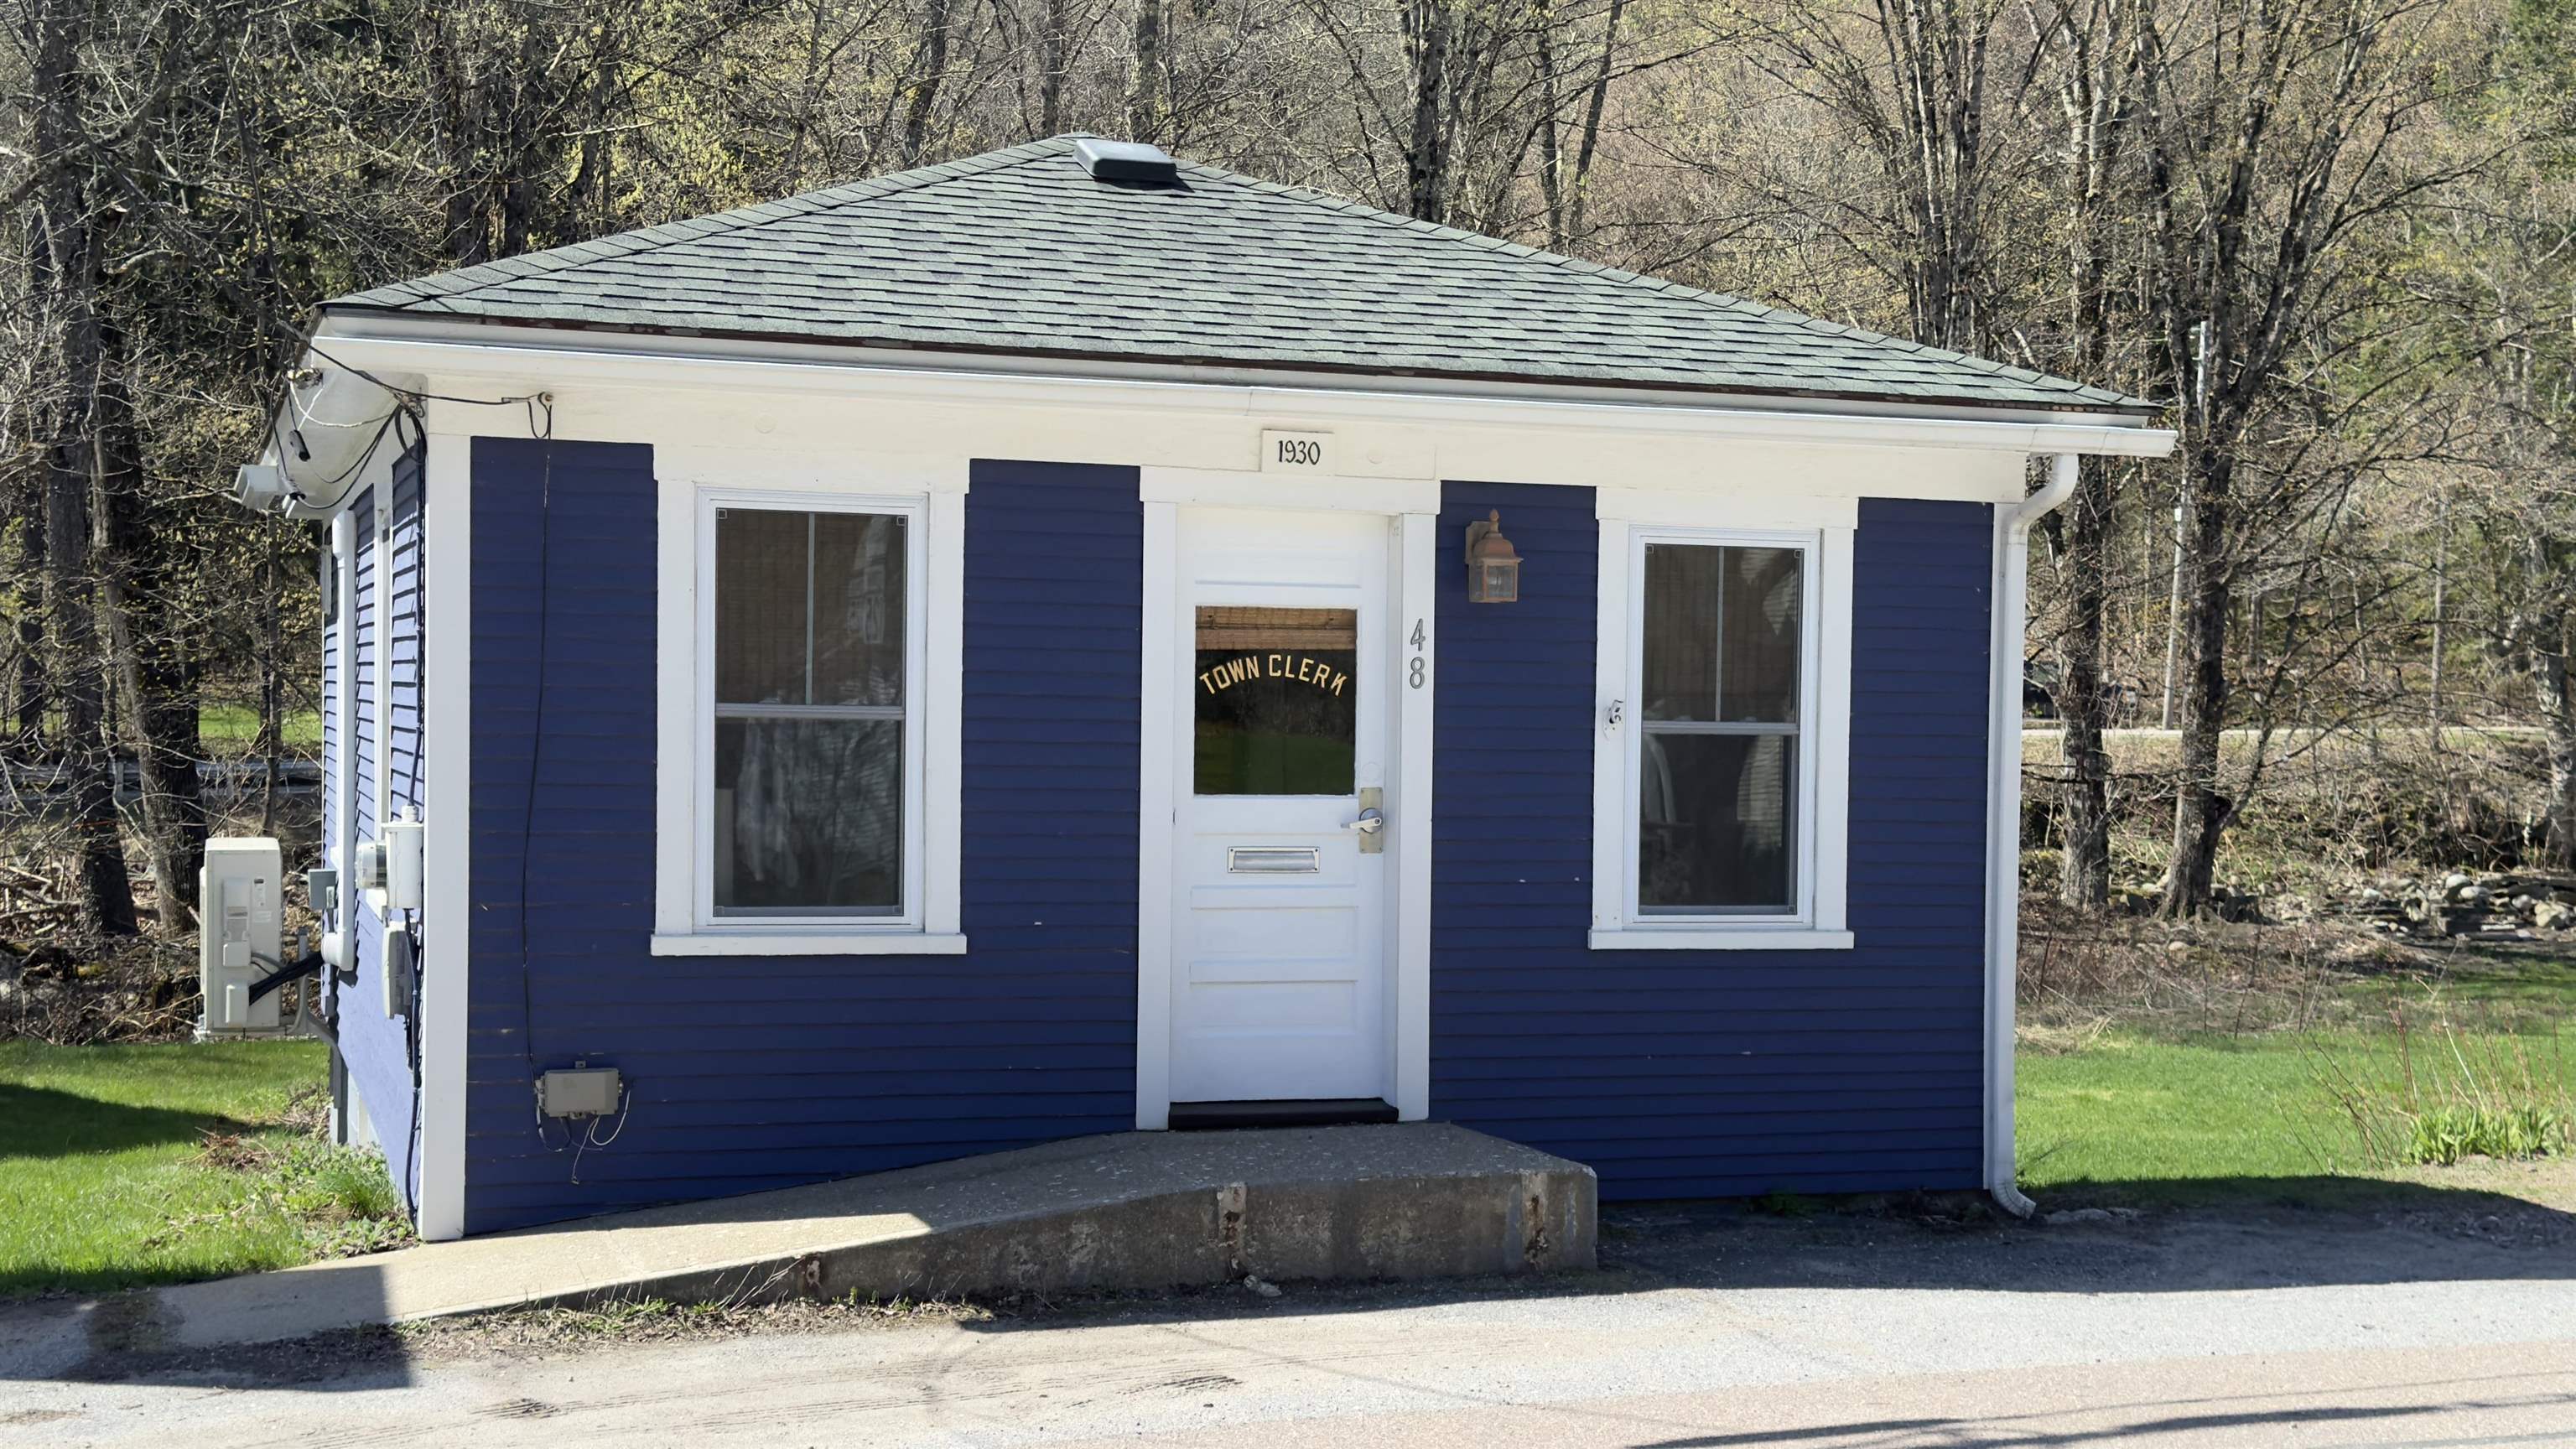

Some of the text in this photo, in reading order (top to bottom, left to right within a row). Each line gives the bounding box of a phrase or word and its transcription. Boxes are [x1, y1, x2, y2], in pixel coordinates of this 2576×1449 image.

[1277, 439, 1321, 465] 1930
[1410, 617, 1426, 690] 48
[1199, 654, 1348, 697] TOWN CLERK
